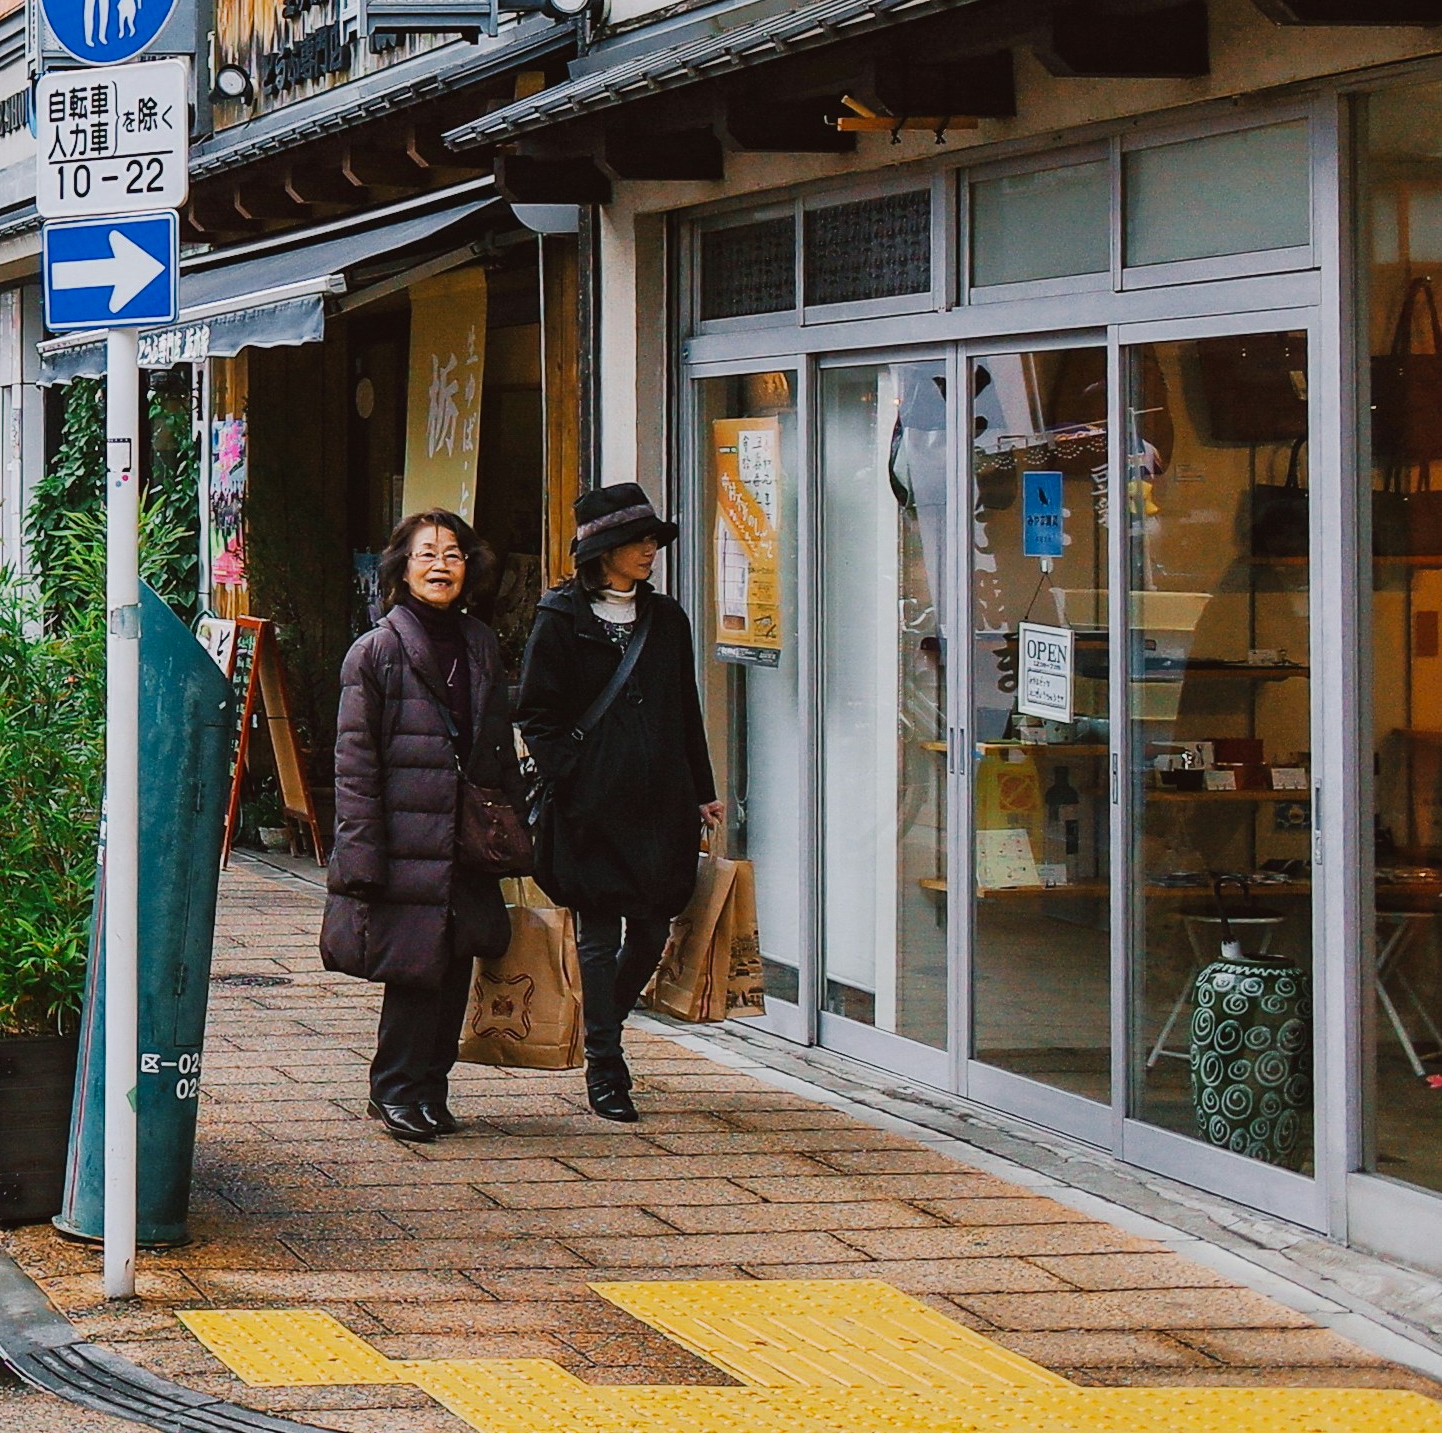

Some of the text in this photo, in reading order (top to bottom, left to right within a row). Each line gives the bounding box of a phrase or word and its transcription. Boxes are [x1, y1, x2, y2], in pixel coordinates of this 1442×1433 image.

[49, 83, 173, 133] 自転車 を除く
[48, 120, 109, 160] 人力車
[1027, 639, 1068, 664] OPEN
